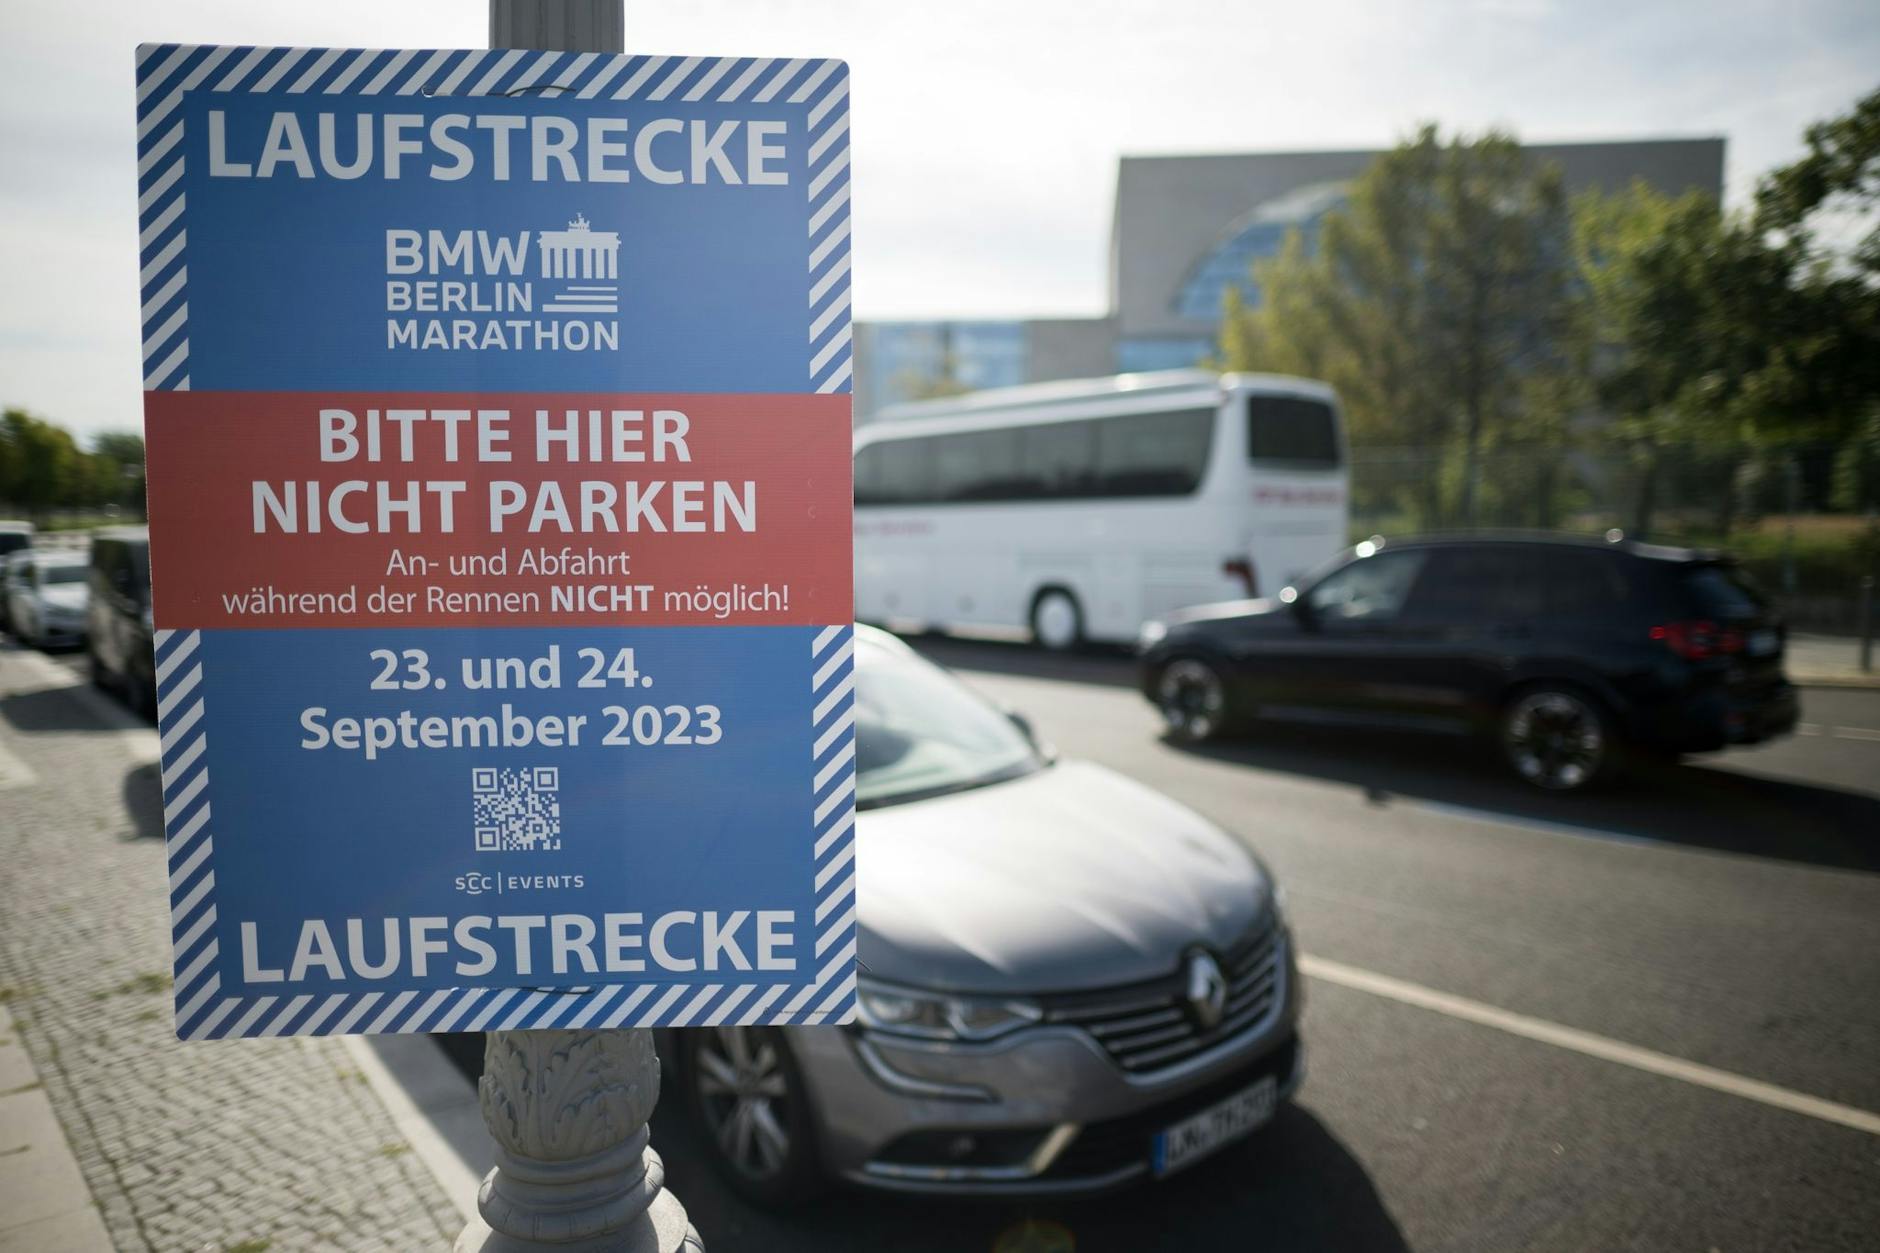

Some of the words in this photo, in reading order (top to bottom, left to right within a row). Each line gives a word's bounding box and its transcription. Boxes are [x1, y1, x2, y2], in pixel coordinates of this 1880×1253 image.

[209, 111, 791, 188] LAUFSTRECKE
[387, 230, 530, 275] BMW
[387, 281, 532, 312] BERLIN
[388, 319, 618, 351] MARATHON
[320, 409, 512, 462] BITTE
[536, 410, 691, 462] HIER
[252, 480, 466, 533] NICHT
[489, 480, 756, 533] PARKEN
[386, 549, 438, 576] An-
[450, 548, 507, 576] und
[518, 546, 630, 575] Abfahrt
[223, 585, 356, 614] während
[367, 585, 416, 613] der
[427, 586, 540, 613] Rennen
[551, 585, 653, 612] NICHT
[664, 584, 788, 619] möglich!
[370, 649, 446, 690] 23.
[462, 645, 560, 689] und
[578, 648, 653, 688] 24.
[300, 704, 587, 760] September
[602, 705, 722, 745] 2023
[455, 872, 492, 894] SCC
[508, 875, 584, 889] EVENTS
[241, 910, 796, 984] LAUFSTRECKE
